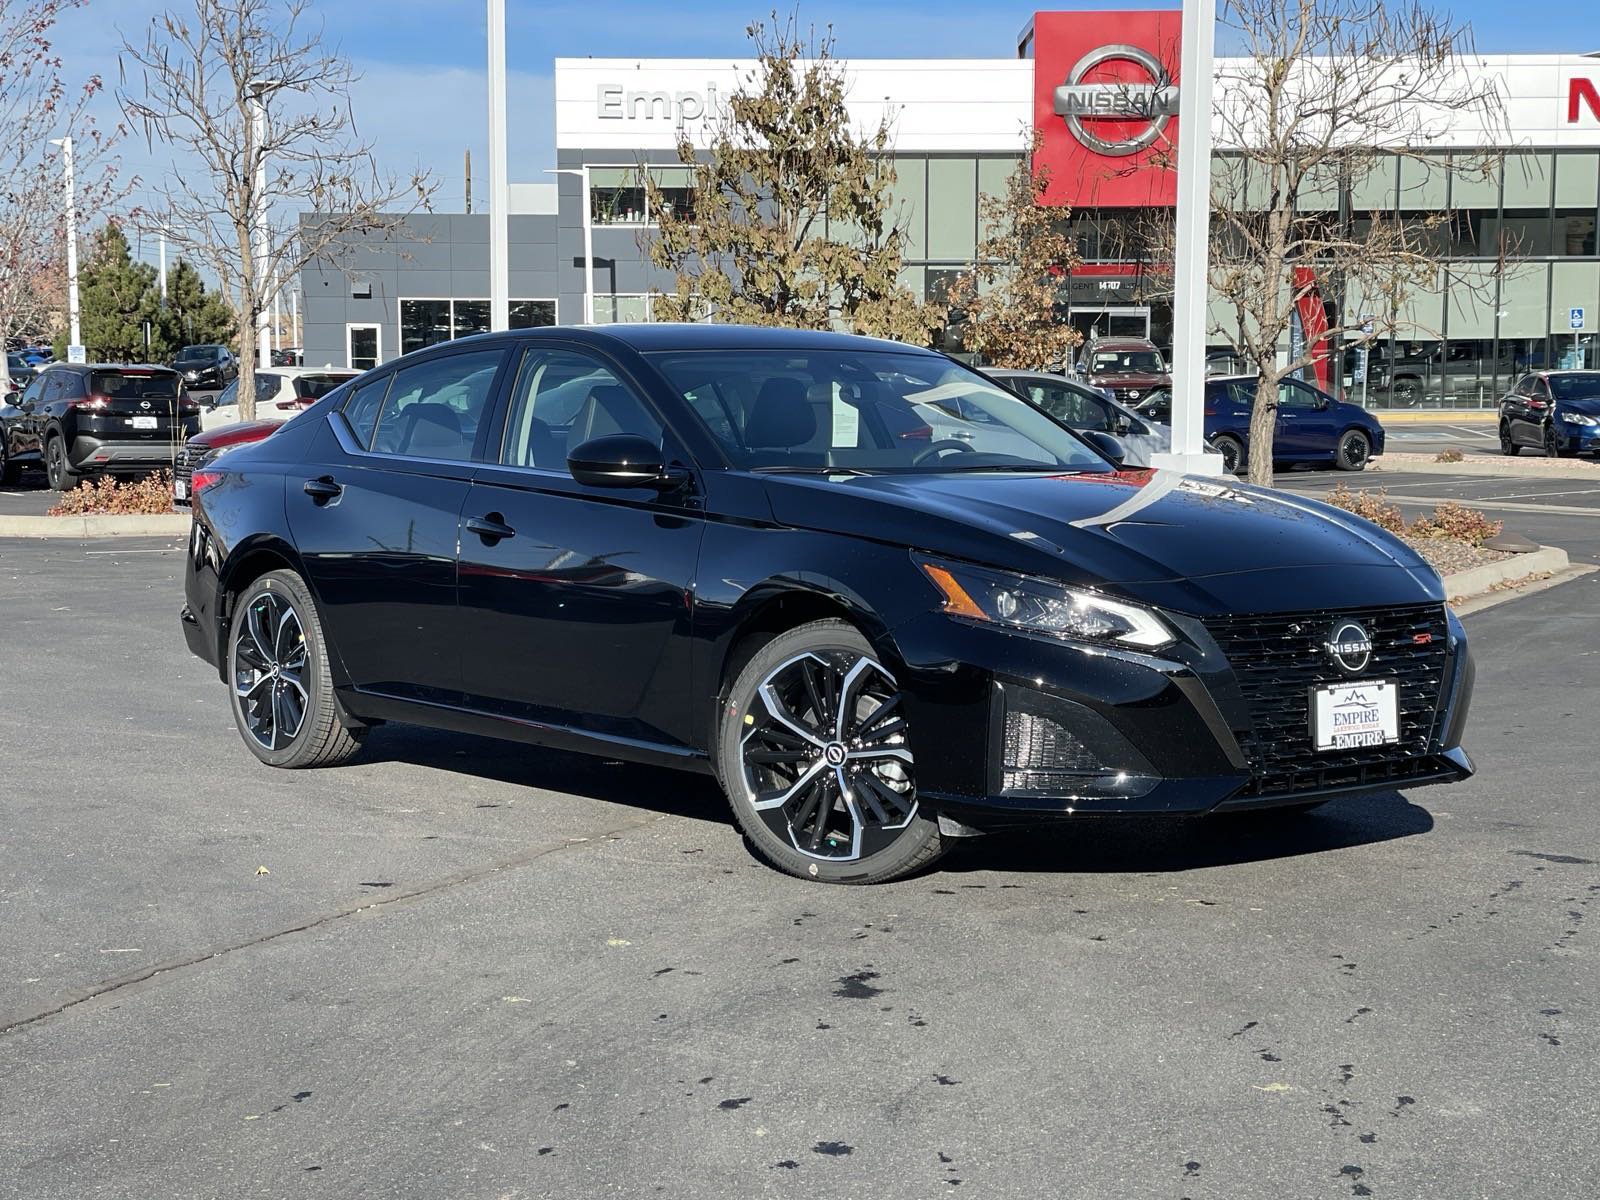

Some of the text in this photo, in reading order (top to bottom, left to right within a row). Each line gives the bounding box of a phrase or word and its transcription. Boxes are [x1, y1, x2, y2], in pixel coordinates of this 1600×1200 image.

[1067, 91, 1169, 109] NISSAN
[1330, 641, 1373, 654] NISSAN
[1333, 709, 1380, 727] EMPIRE
[1336, 730, 1383, 750] EMPIRE
